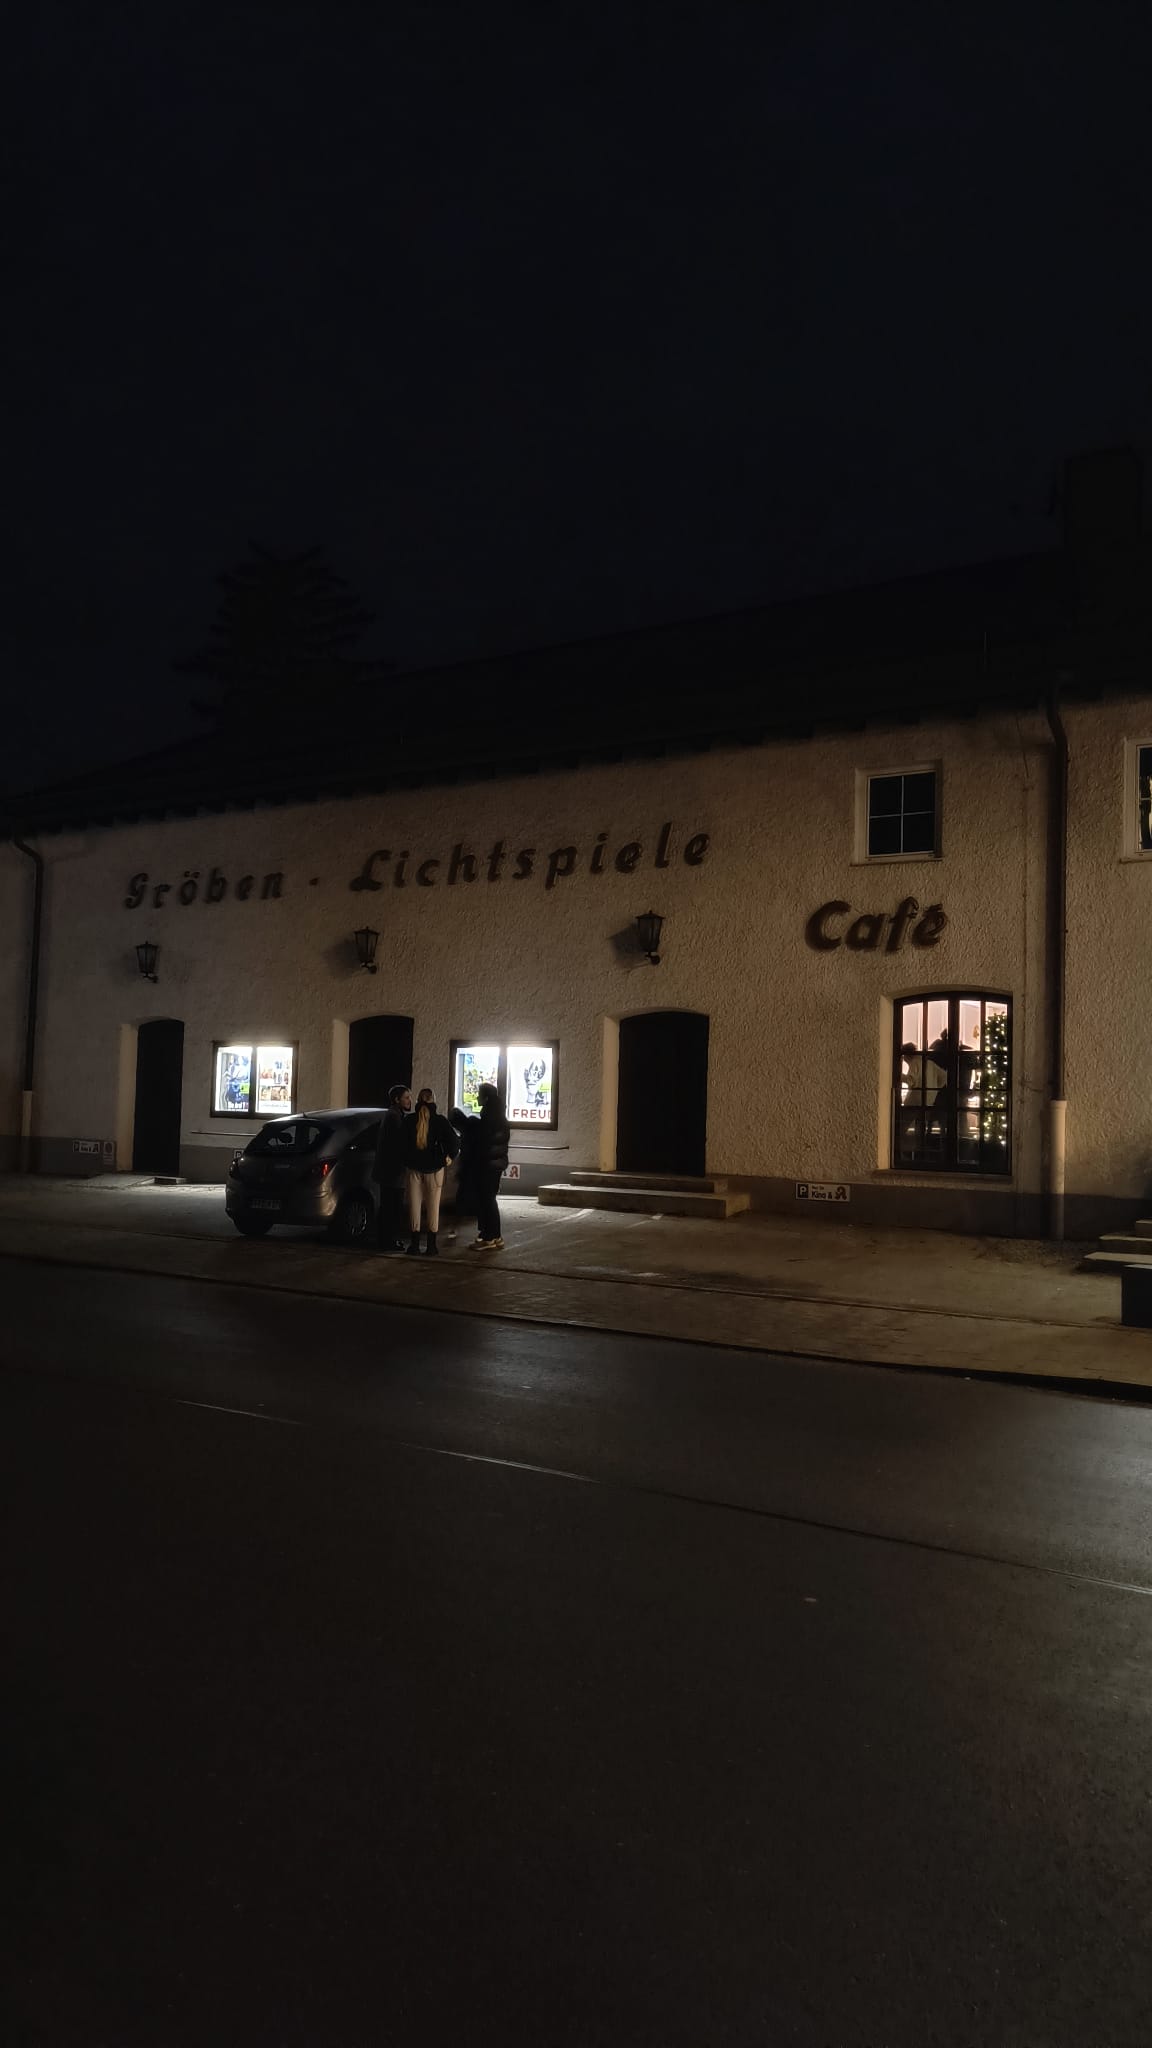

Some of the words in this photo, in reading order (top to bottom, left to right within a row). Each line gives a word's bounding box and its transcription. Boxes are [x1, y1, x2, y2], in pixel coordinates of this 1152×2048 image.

[125, 867, 284, 909] Gröben
[350, 822, 710, 891] Lichtspiele
[805, 896, 948, 954] Café
